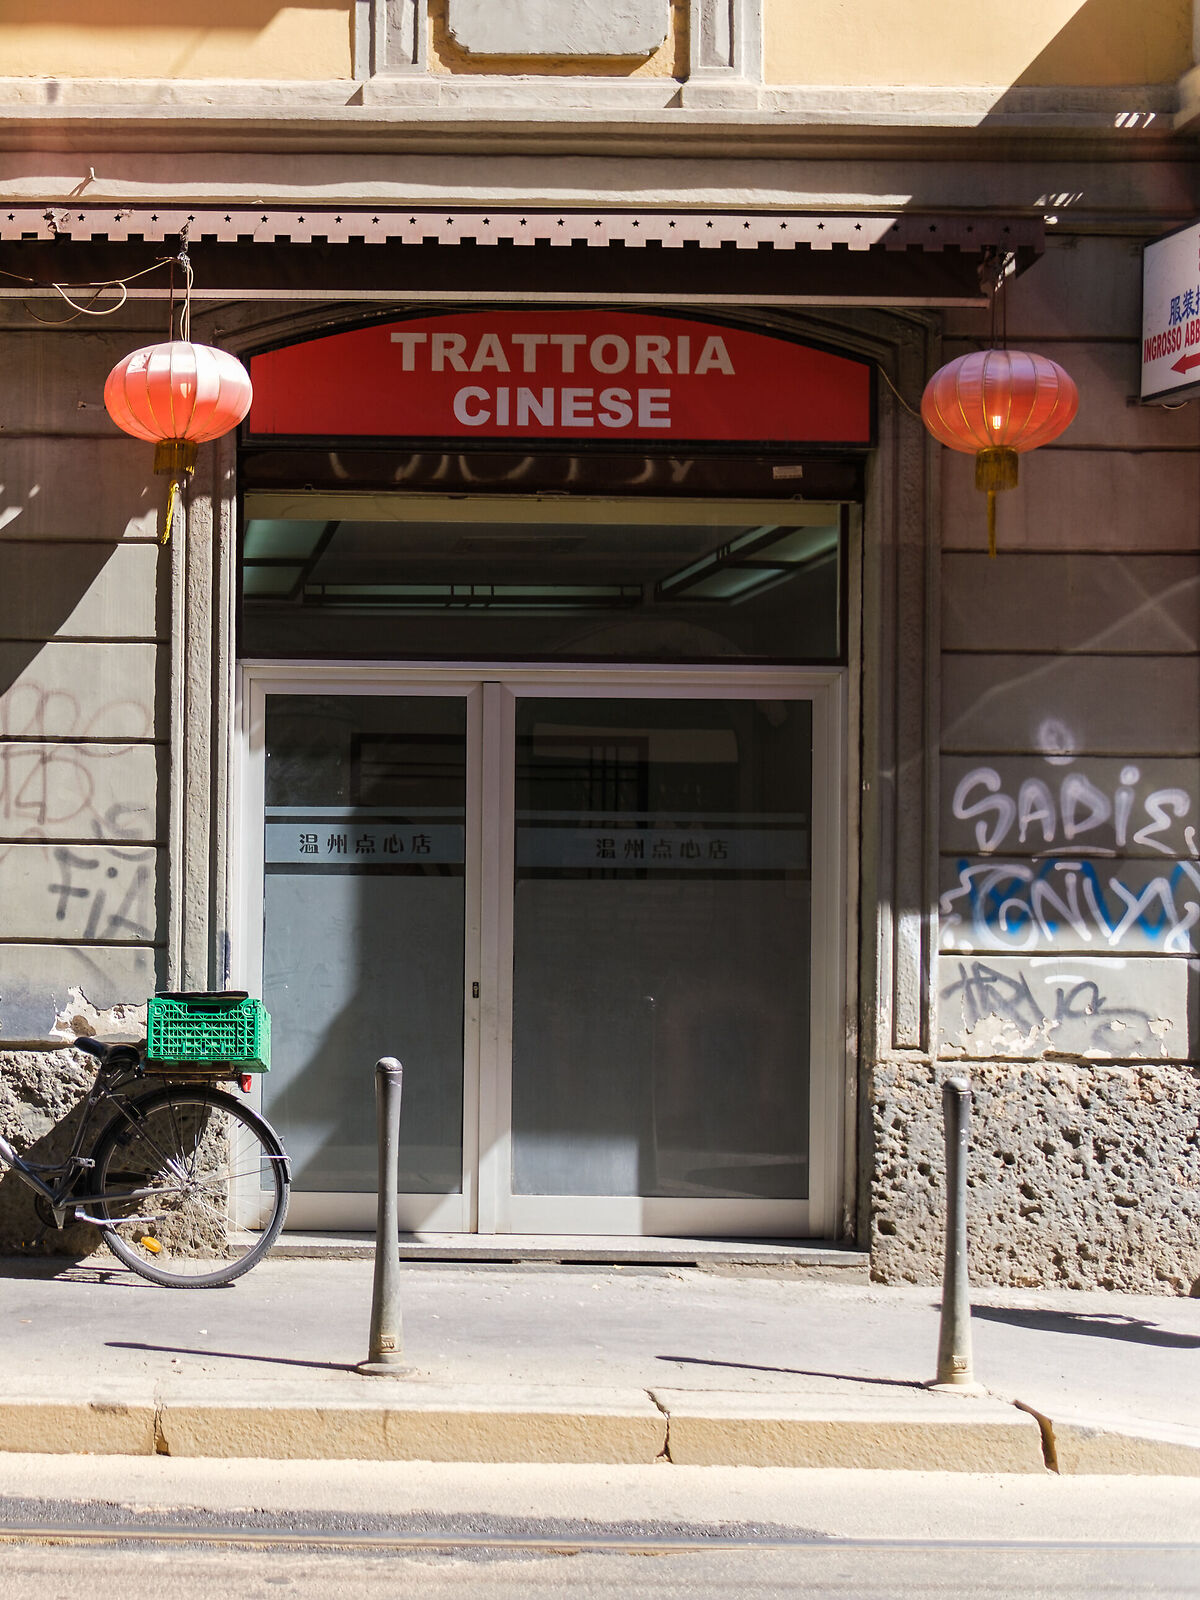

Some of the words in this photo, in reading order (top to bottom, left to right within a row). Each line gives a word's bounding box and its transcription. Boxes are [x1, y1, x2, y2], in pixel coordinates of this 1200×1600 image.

[390, 332, 736, 376] TRATTORIA
[1143, 326, 1182, 363] INGROSSO
[452, 385, 672, 428] CINESE
[299, 833, 432, 854] 温州点心店
[596, 838, 729, 860] 温州点心店
